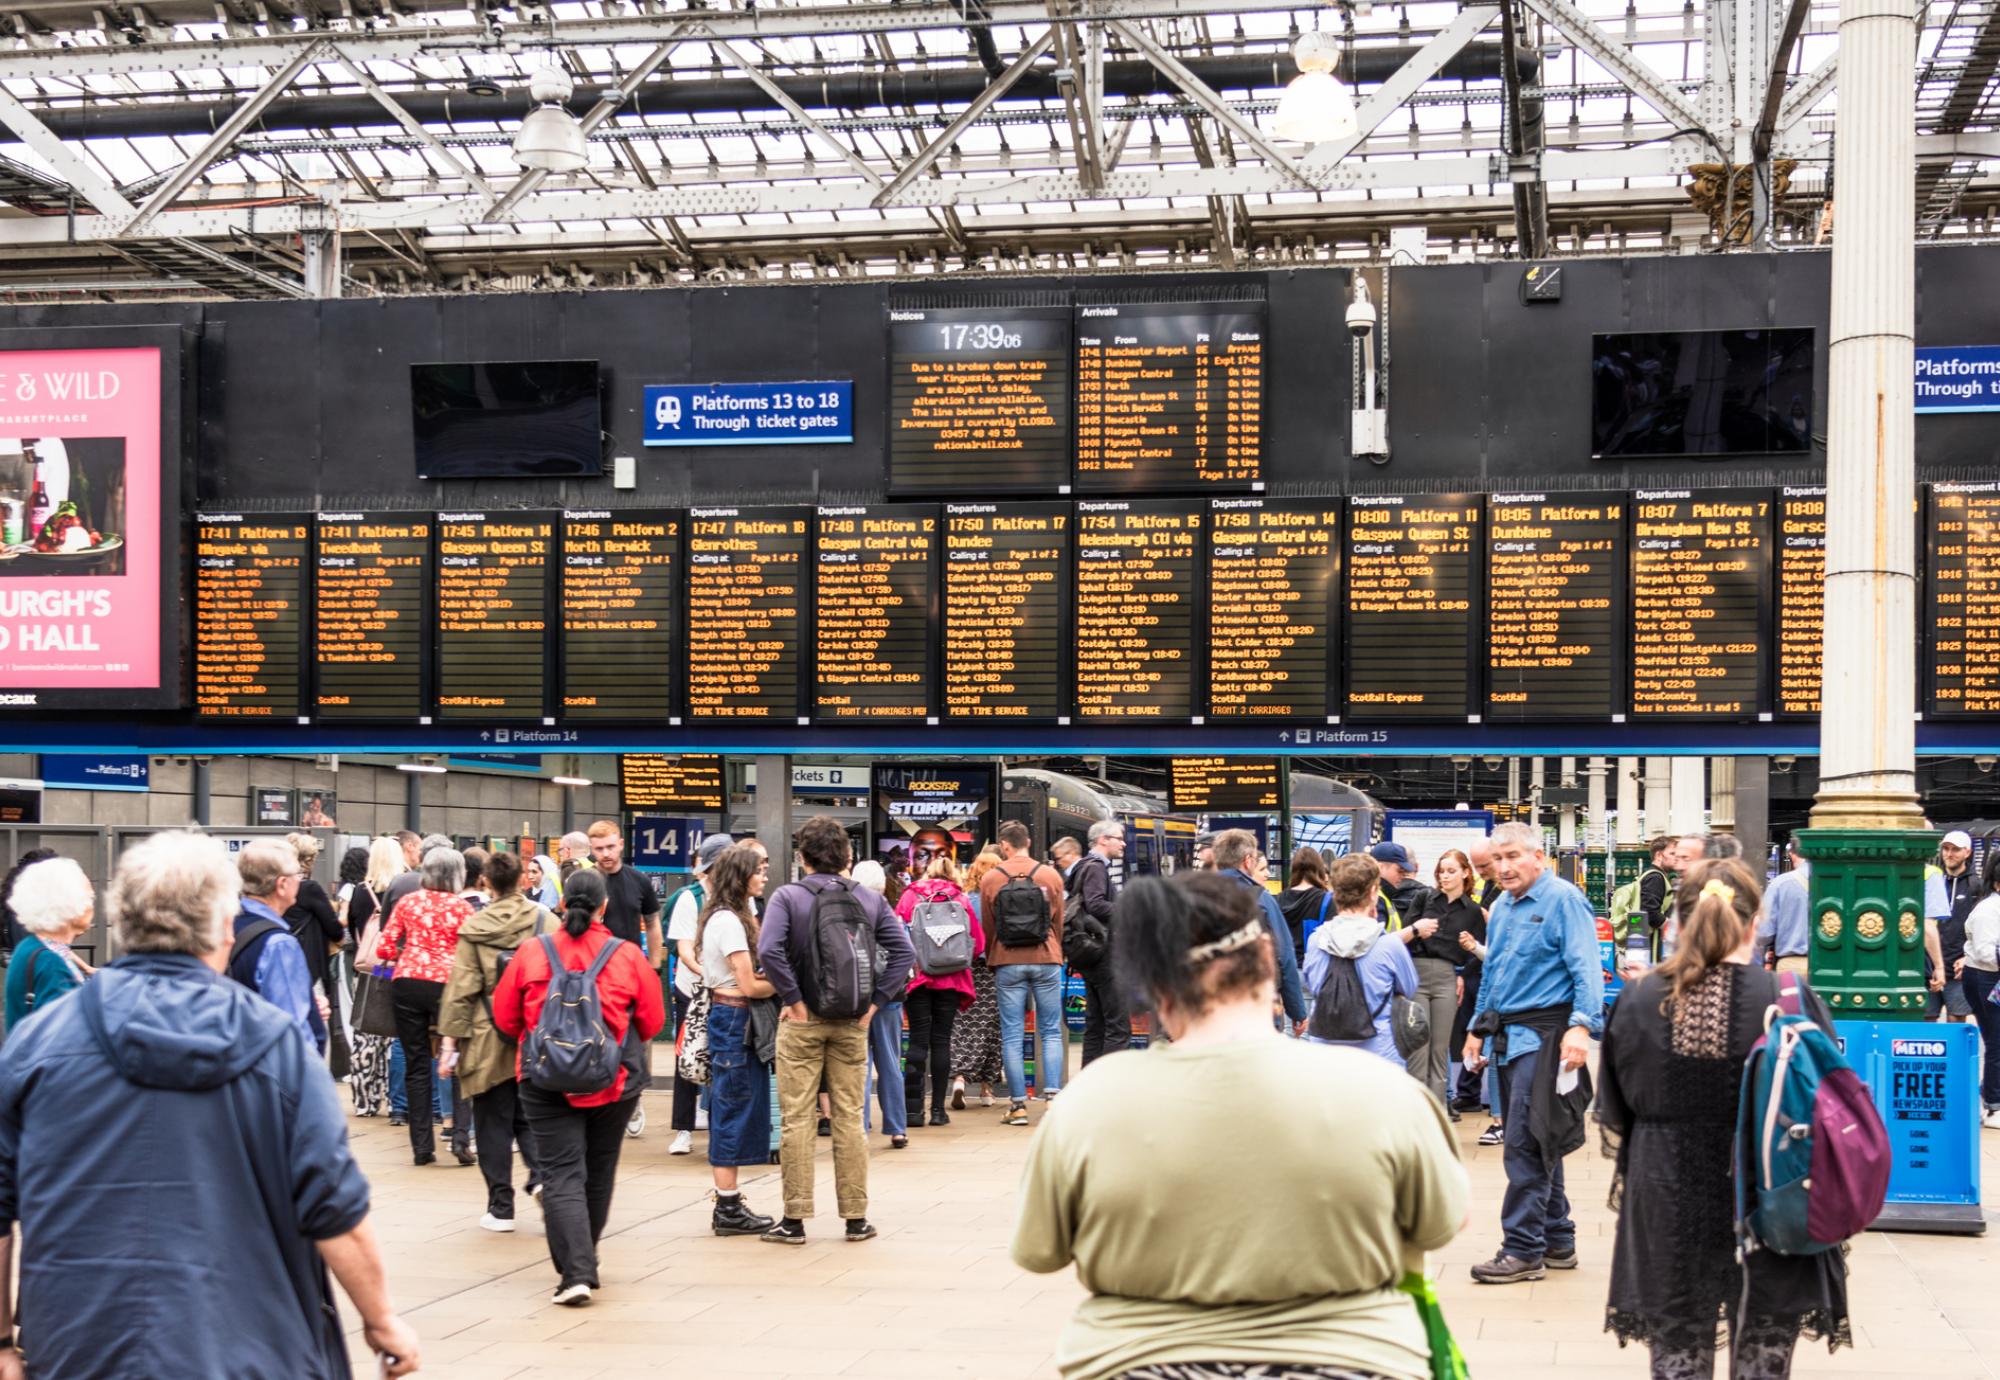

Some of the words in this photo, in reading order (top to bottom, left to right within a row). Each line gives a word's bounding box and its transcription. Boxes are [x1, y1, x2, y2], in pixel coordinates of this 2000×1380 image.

[891, 312, 925, 320] Notices
[1082, 308, 1118, 316] Arrivals
[1232, 333, 1259, 341] Status
[1227, 345, 1260, 353] Arrived
[912, 363, 929, 372] Due
[957, 363, 990, 371] broken
[1020, 361, 1046, 369] train
[998, 373, 1042, 381] services
[16, 373, 36, 401] &
[43, 372, 120, 400] WILD
[947, 385, 982, 395] subject
[987, 385, 998, 393] to
[1001, 385, 1032, 393] delay,
[1915, 381, 1982, 398] Through
[693, 396, 769, 411] Platforms
[773, 395, 793, 409] 13
[797, 395, 814, 409] to
[819, 393, 839, 408] 18
[914, 397, 965, 405] alteration
[979, 396, 1044, 404] cancellation.
[693, 415, 750, 431] Through
[756, 415, 796, 428] ticket
[800, 415, 838, 430] gates
[901, 419, 948, 428] Inverness
[967, 418, 1016, 427] currently
[1019, 417, 1055, 425] CLOSED.
[941, 430, 969, 438] 03457
[935, 441, 1022, 449] nationalrail.co.uk
[1200, 471, 1223, 480] Page
[1237, 470, 1248, 478] of
[1252, 470, 1258, 478] 2
[1934, 484, 1994, 493] Subsequent
[1351, 496, 1403, 505] Departures
[1492, 494, 1545, 503] Departures
[1636, 490, 1690, 500] Departures
[947, 505, 996, 513] Departures
[1079, 503, 1129, 511] Departures
[1212, 499, 1263, 509] Departures
[1785, 502, 1824, 515] 18:08
[564, 511, 611, 519] Departures
[691, 509, 738, 517] Departures
[818, 507, 866, 515] Departures
[1354, 511, 1390, 523] 18:00
[1401, 510, 1458, 523] Platform
[1466, 510, 1477, 521] 11
[1494, 509, 1531, 522] 18:05
[1541, 509, 1599, 521] Platform
[1607, 507, 1620, 520] 14
[1639, 506, 1676, 518] 18:07
[1693, 505, 1752, 518] Platform
[1758, 504, 1768, 517] 7
[318, 513, 364, 521] Departures
[439, 513, 485, 521] Departures
[1081, 517, 1115, 529] 17:54
[1126, 516, 1180, 528] Platform
[1187, 516, 1199, 527] 15
[1215, 514, 1249, 526] 17:58
[1260, 514, 1315, 526] Platform
[1323, 513, 1335, 525] 14
[693, 522, 725, 534] 17:47
[735, 522, 786, 534] Platform
[820, 521, 854, 533] 17:48
[863, 521, 916, 532] Platform
[922, 520, 934, 531] 12
[950, 519, 983, 530] 17:50
[993, 518, 1046, 530] Platform
[1053, 517, 1065, 529] 17
[1707, 523, 1730, 534] New
[1735, 523, 1750, 534] St
[321, 527, 351, 537] 17:41
[359, 527, 408, 537] Platform
[412, 526, 427, 537] 20
[443, 526, 475, 537] 17:45
[484, 525, 533, 537] Platform
[540, 525, 551, 537] 14
[567, 524, 600, 535] 17:46
[613, 524, 665, 536] Platform
[669, 524, 677, 535] 2
[1352, 529, 1402, 542] Glasgow
[1408, 528, 1448, 541] Queen
[1454, 528, 1468, 539] St
[1492, 527, 1551, 539] Dunblane
[948, 536, 992, 547] Dundee
[1079, 534, 1148, 546] Helensburgh
[1174, 534, 1192, 545] via
[1262, 531, 1305, 543] Central
[1310, 531, 1328, 542] via
[320, 543, 381, 553] Tweedbank
[442, 542, 486, 554] Glasgow
[491, 542, 526, 553] Queen
[531, 541, 545, 553] St
[565, 541, 600, 552] North
[605, 541, 650, 552] Berwick
[691, 540, 757, 551] Glenrothes
[19, 624, 100, 651] HALL
[1388, 694, 1423, 702] Express
[514, 731, 560, 741] Platform
[563, 731, 578, 741] 14
[1316, 731, 1368, 741] Platform
[1371, 731, 1387, 741] 15
[909, 782, 960, 790] ROCKSTAR
[889, 802, 979, 815] STORMZY
[643, 829, 678, 855] 14
[1895, 1042, 1945, 1056] METRO
[1893, 1062, 1910, 1071] PICK
[1912, 1062, 1923, 1071] UP
[1926, 1062, 1946, 1071] YOUR
[1894, 1073, 1946, 1098] FREE
[1893, 1100, 1946, 1109] NEWSPAPER
